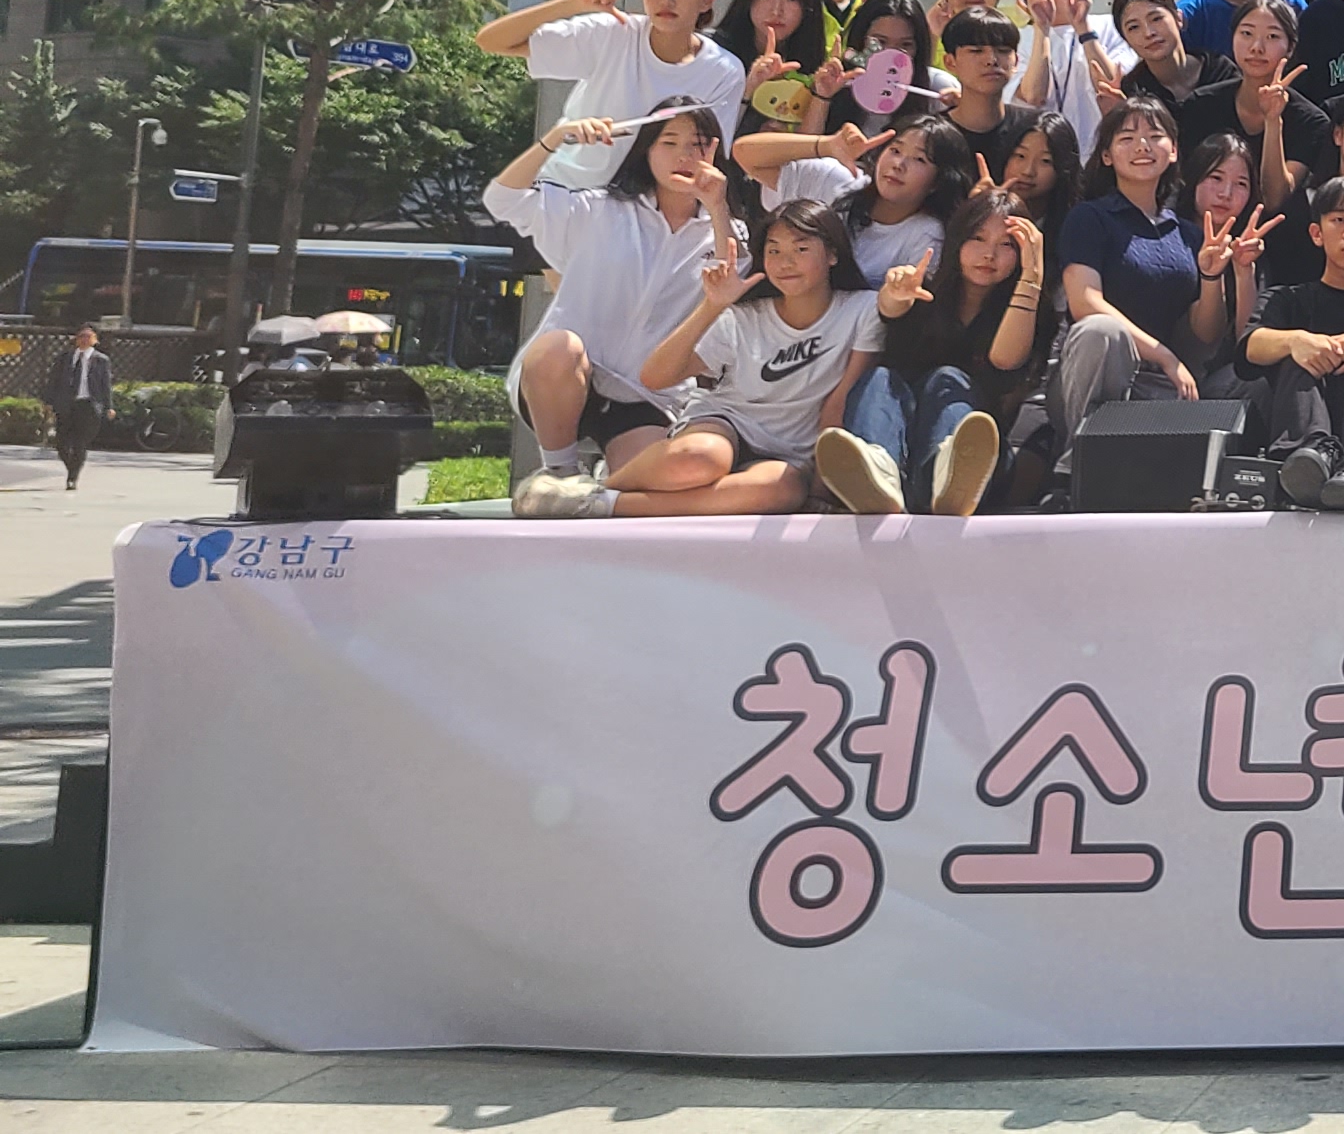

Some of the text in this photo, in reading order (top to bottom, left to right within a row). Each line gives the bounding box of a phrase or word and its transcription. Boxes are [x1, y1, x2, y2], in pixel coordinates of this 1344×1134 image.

[771, 335, 823, 365] NIKE
[234, 534, 355, 567] 강남구
[231, 567, 346, 580] GANG NAM GU
